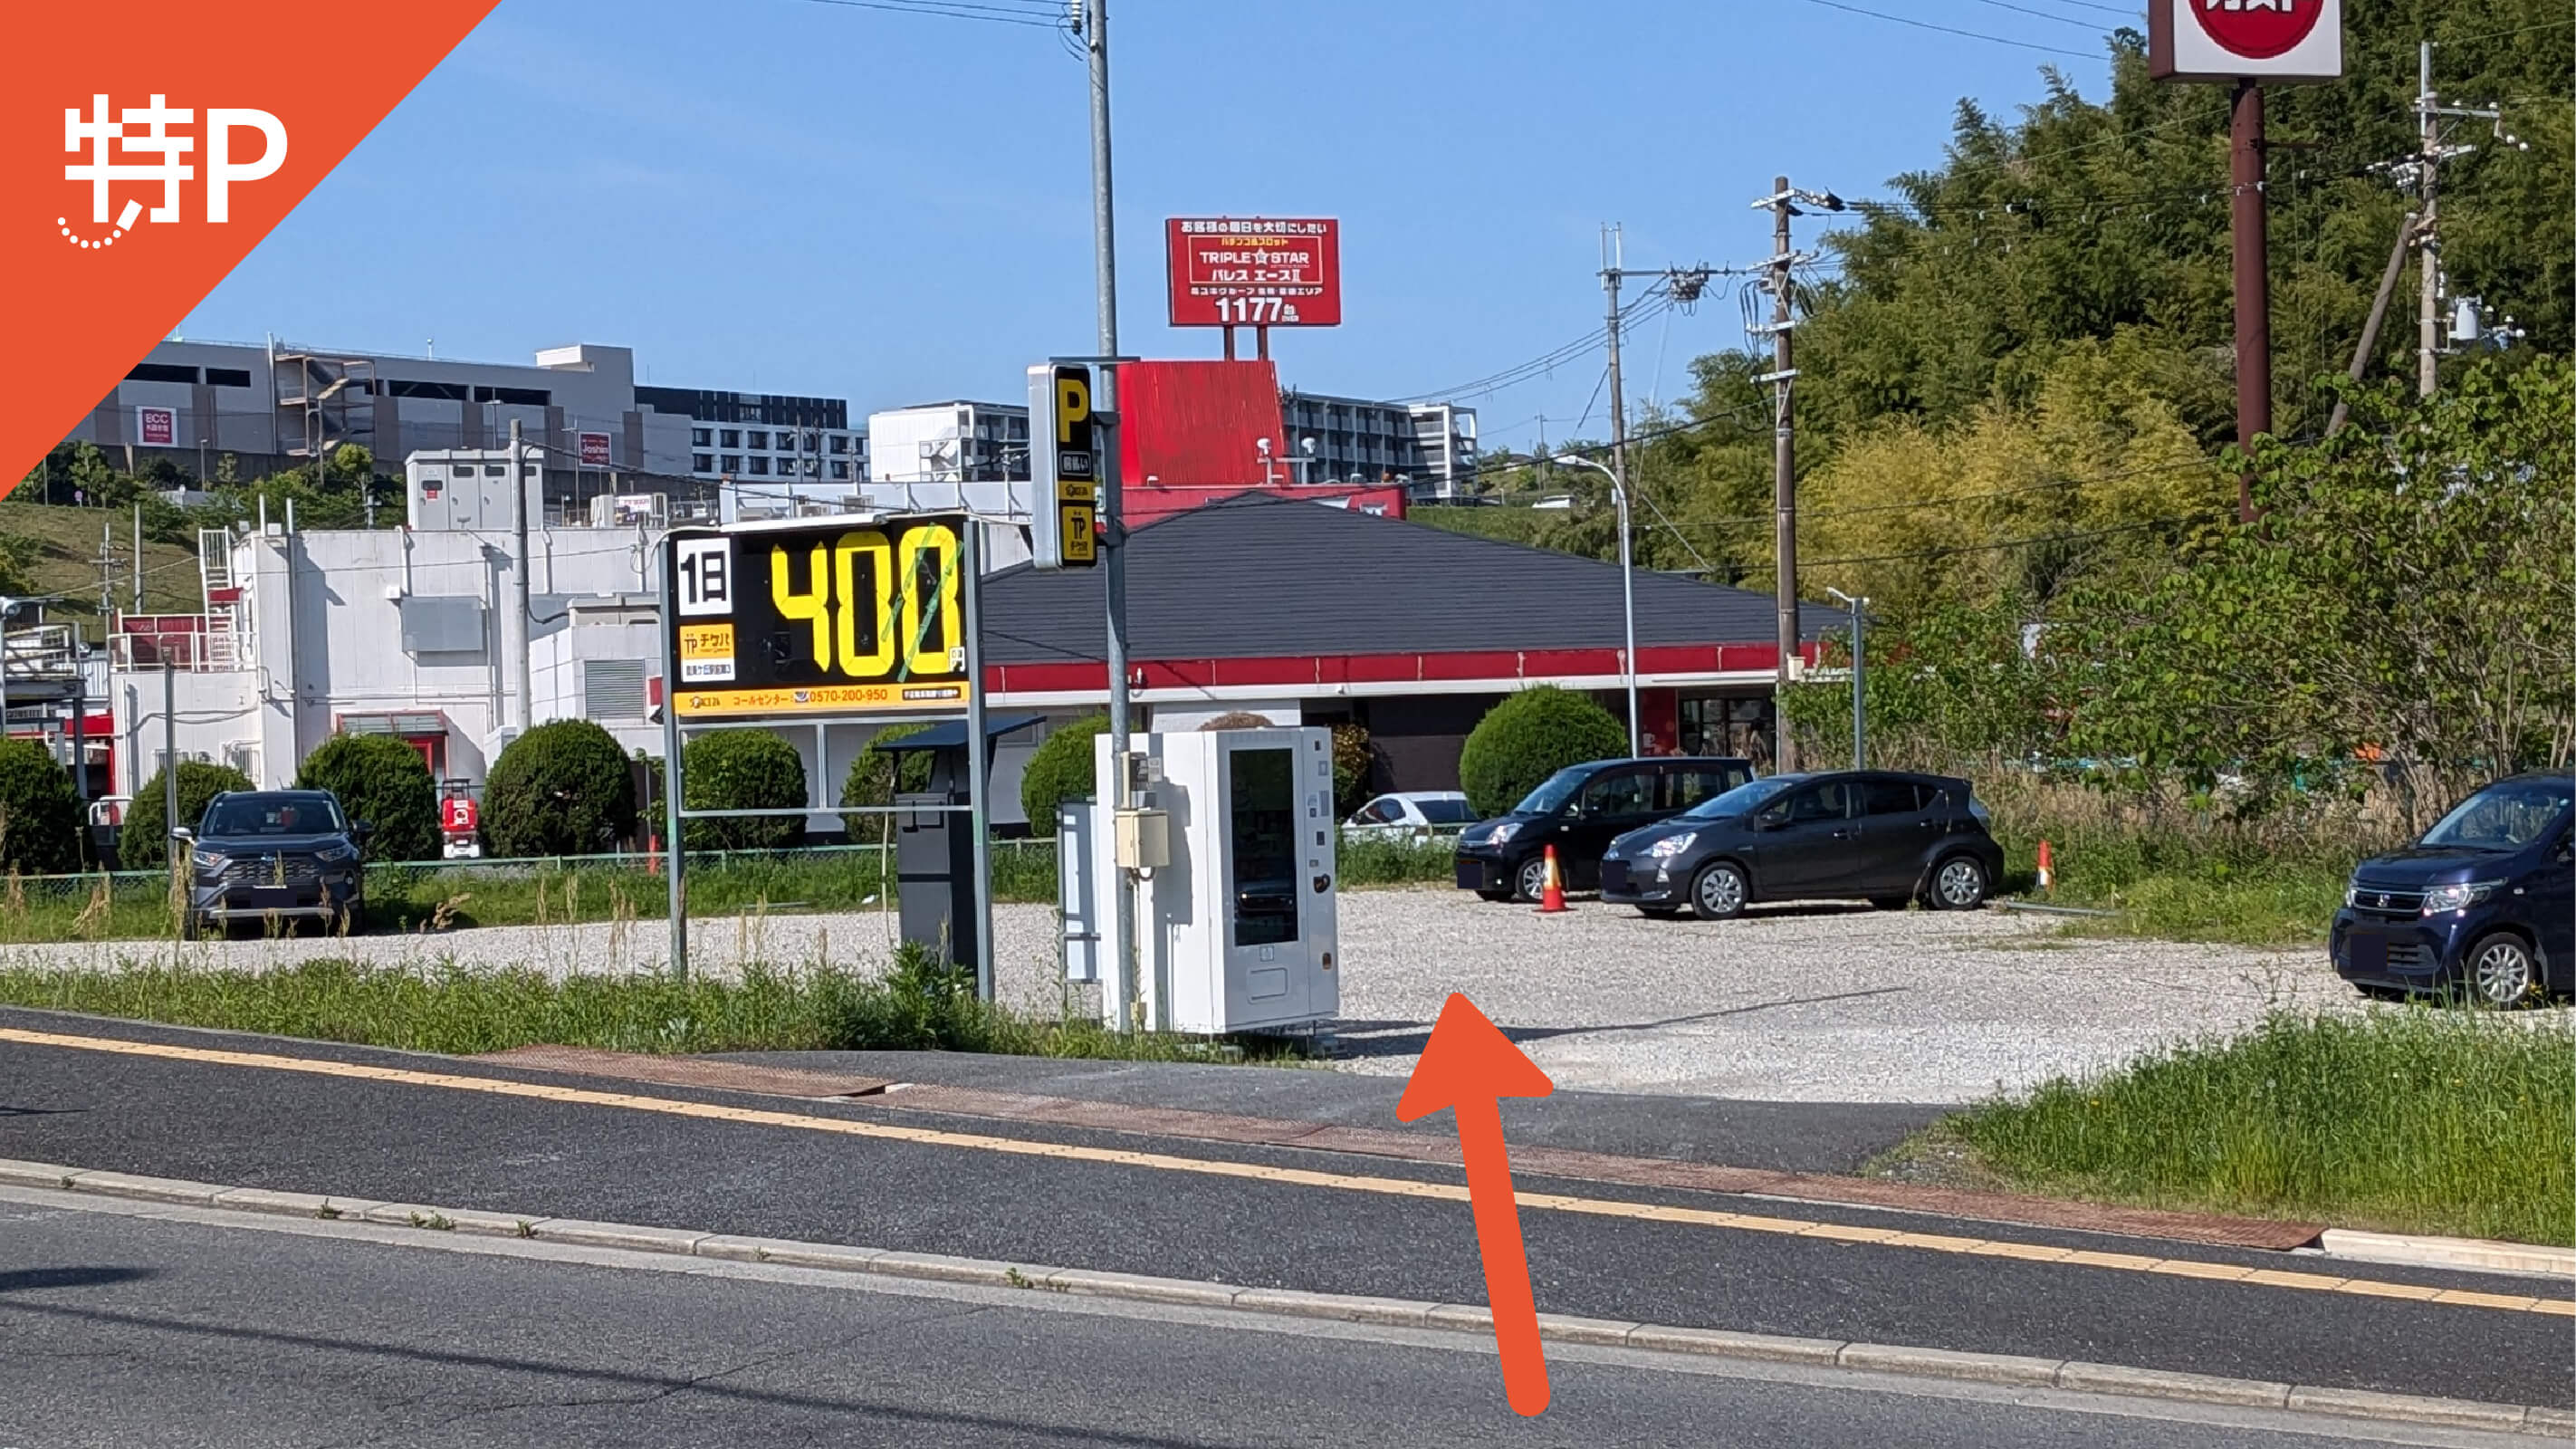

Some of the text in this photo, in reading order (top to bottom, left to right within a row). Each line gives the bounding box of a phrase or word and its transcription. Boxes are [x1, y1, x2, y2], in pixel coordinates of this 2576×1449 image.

[1200, 252, 1309, 264] TRIPLE STAR
[1215, 297, 1282, 321] 1177
[146, 413, 168, 424] ECC
[1058, 379, 1089, 443] P
[680, 551, 727, 605] 1日
[771, 525, 961, 676] 400
[700, 633, 730, 648] チケパ
